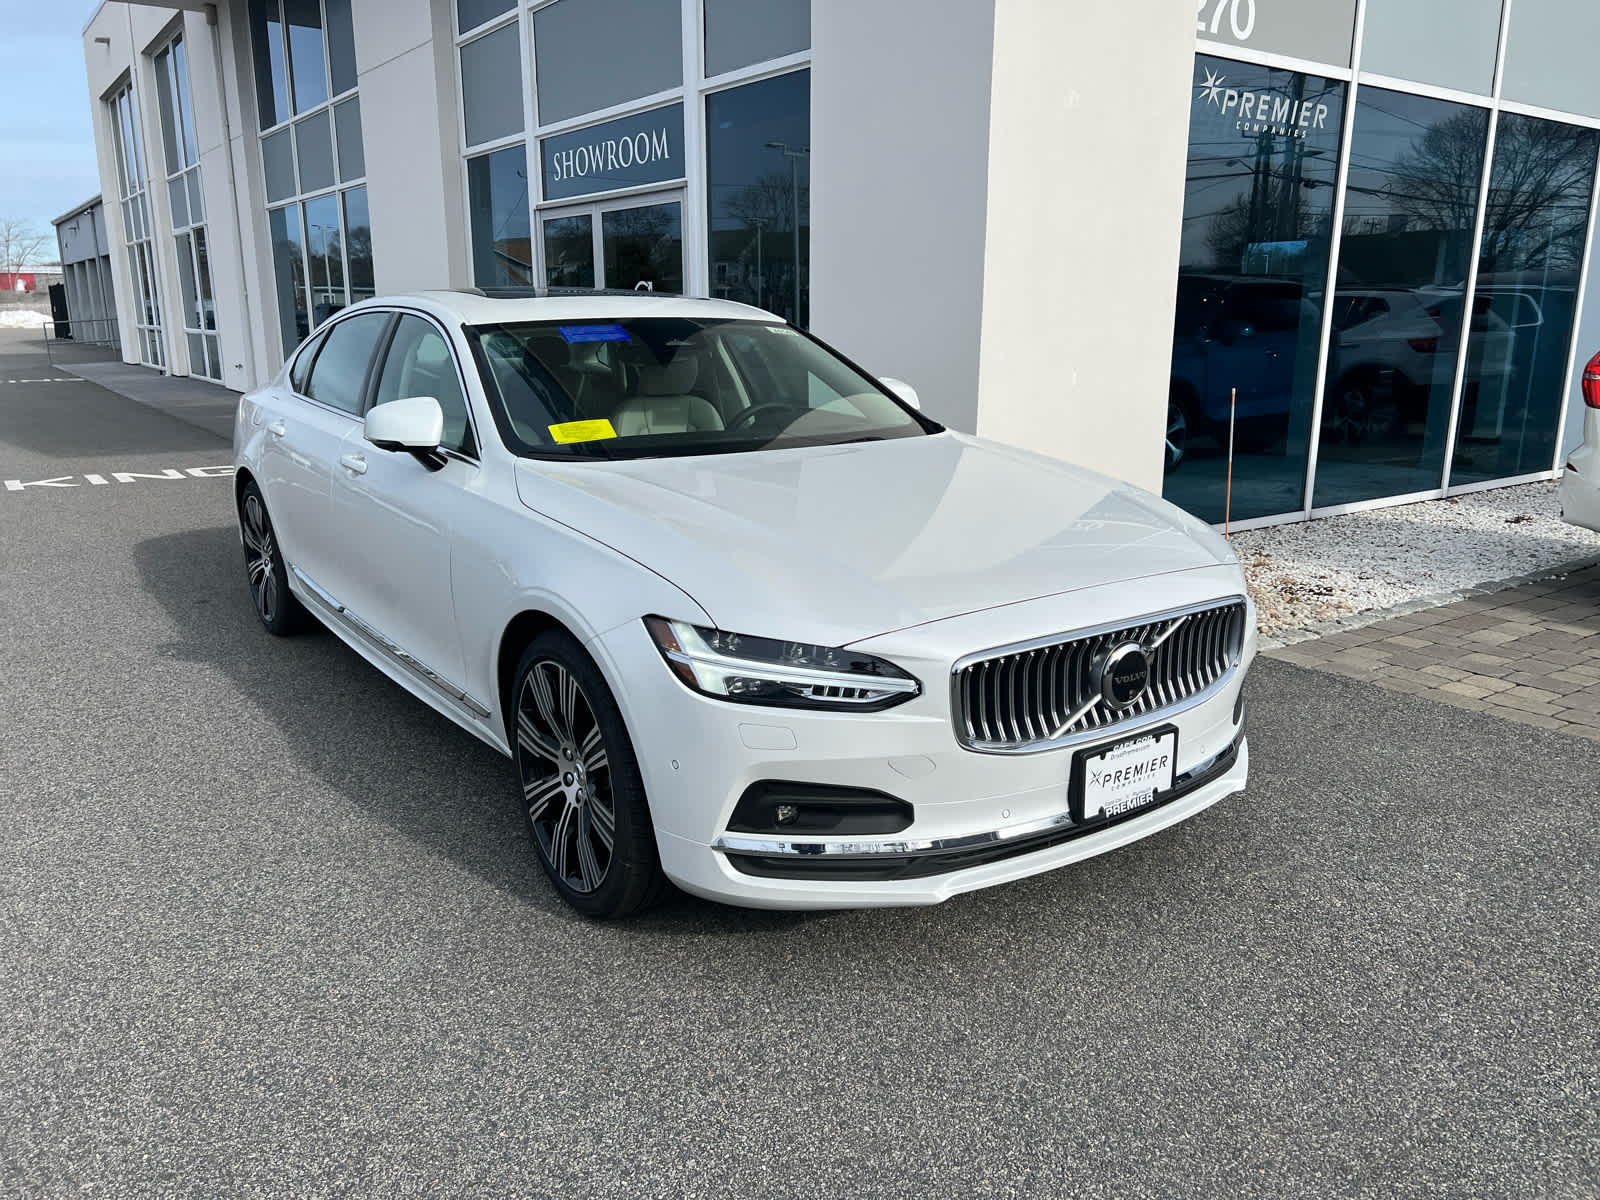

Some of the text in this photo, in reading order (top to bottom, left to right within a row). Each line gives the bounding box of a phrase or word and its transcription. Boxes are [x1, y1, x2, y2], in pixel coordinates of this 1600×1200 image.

[1221, 88, 1328, 129] PREMIER
[1236, 120, 1307, 139] COMPANIES
[553, 127, 670, 181] SHOWROOM
[1114, 671, 1147, 684] VOLVO
[1102, 755, 1168, 788] PREMIER
[1105, 792, 1153, 818] PREMIER
